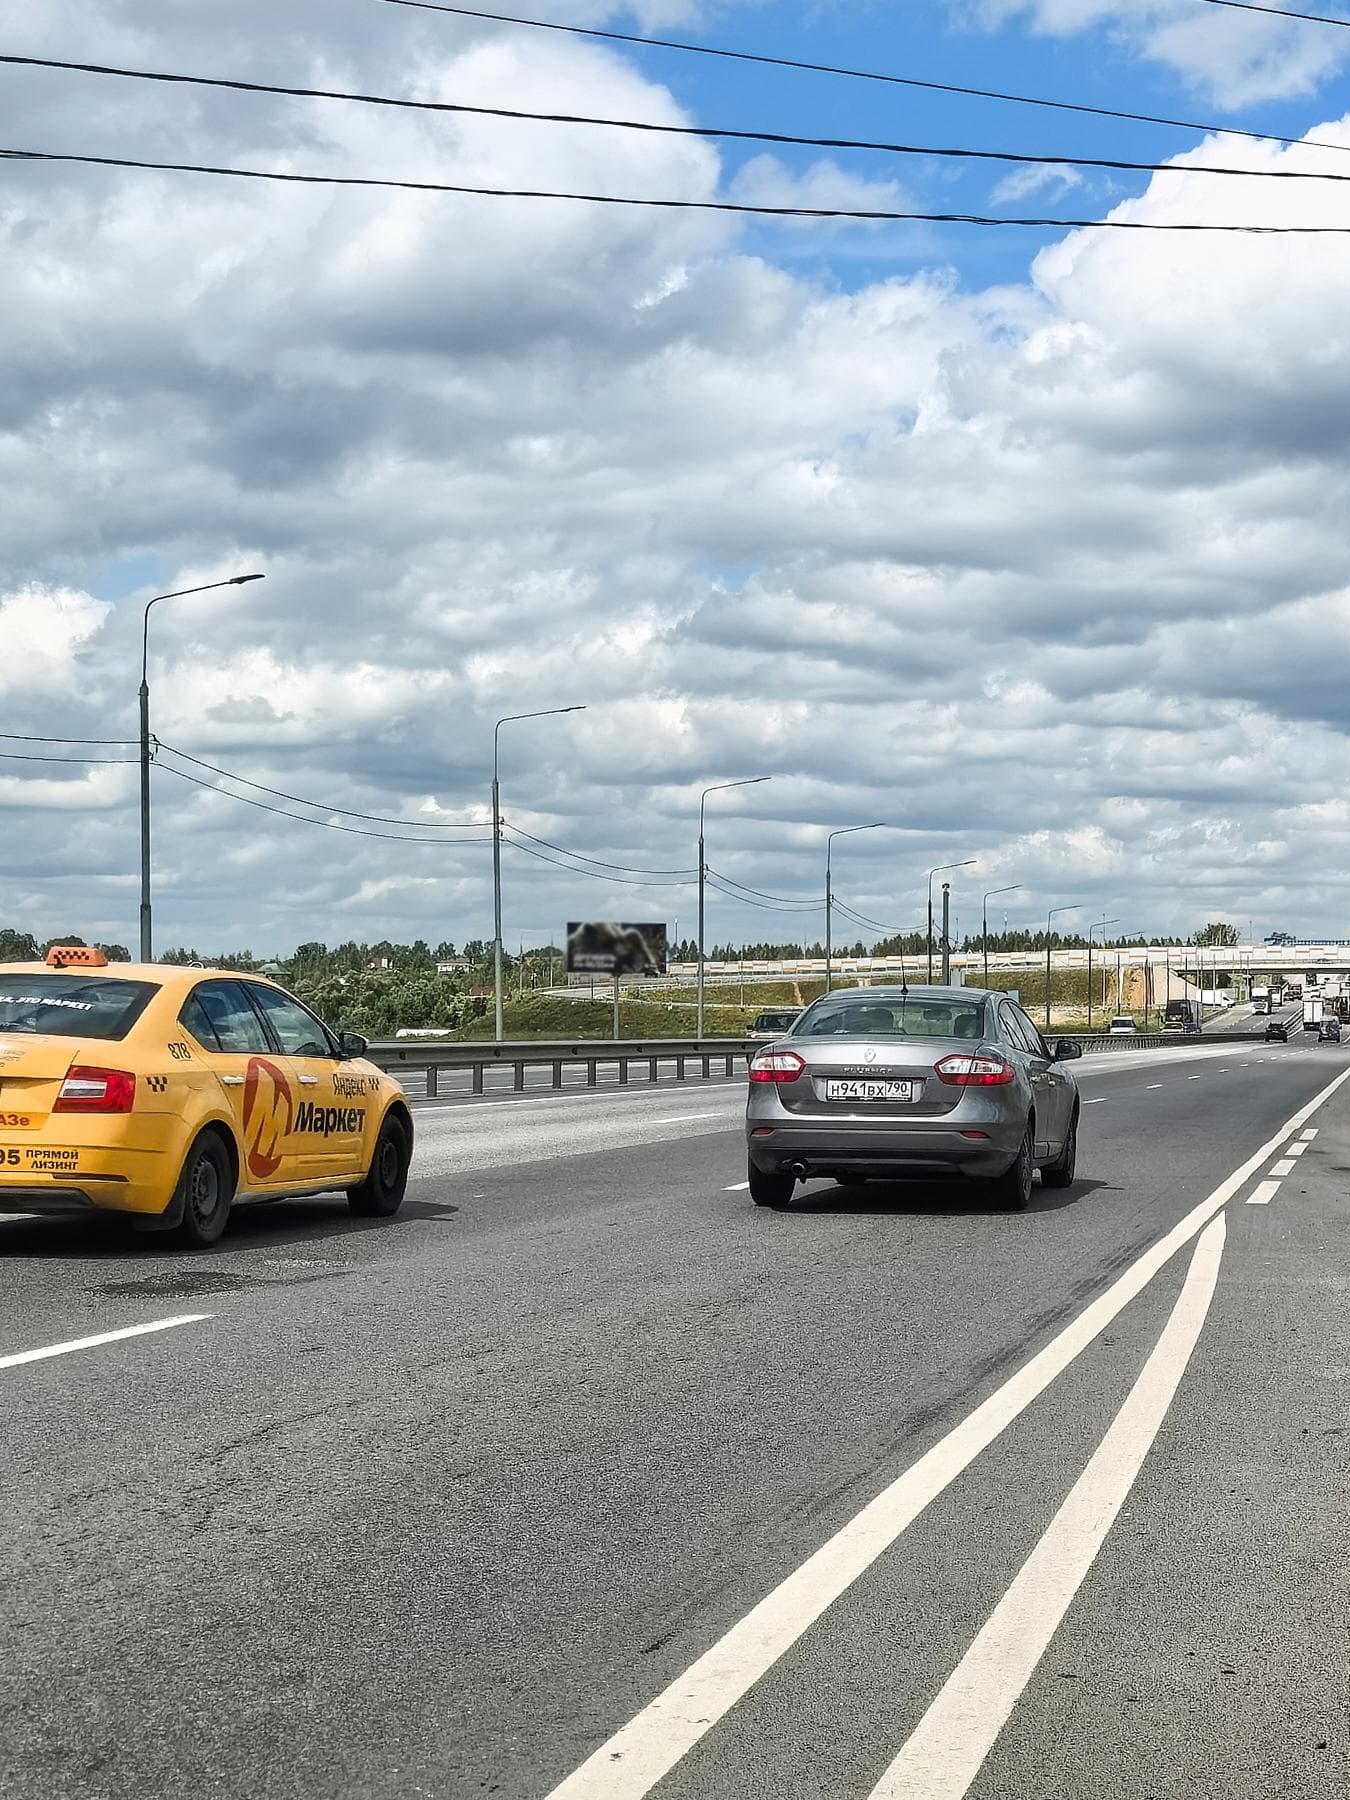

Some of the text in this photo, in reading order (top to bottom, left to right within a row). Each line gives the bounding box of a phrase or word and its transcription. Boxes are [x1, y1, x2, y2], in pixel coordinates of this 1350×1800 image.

[168, 1042, 191, 1059] 878
[333, 1073, 367, 1099] Яндекс
[293, 1101, 366, 1137] Маркет
[26, 1148, 79, 1160] ПРЯМОЙ
[31, 1160, 79, 1170] ЛИЗИНГ
